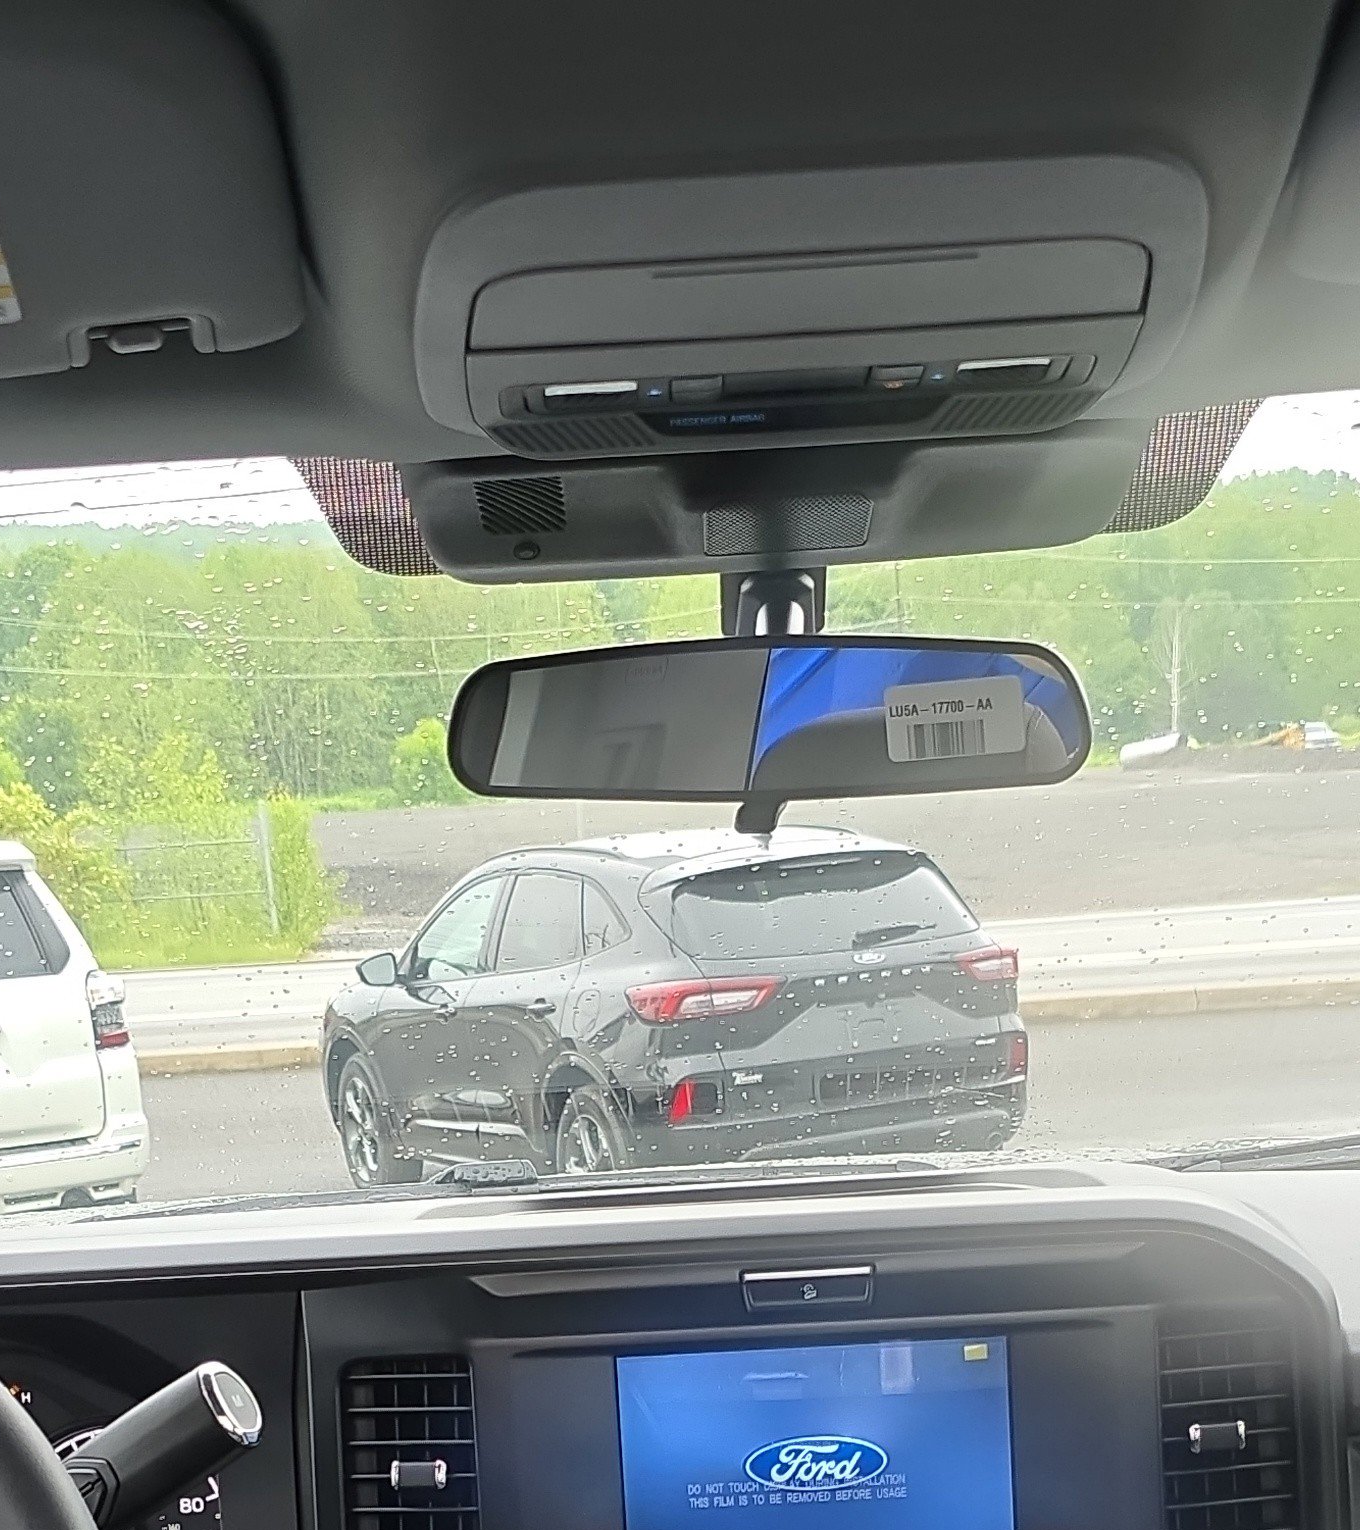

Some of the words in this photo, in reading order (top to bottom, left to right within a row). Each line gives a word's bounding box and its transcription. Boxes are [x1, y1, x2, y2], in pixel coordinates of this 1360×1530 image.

[21, 1392, 31, 1404] H
[770, 1443, 862, 1482] Ford
[687, 1484, 702, 1495] DO
[706, 1482, 724, 1494] NOT
[728, 1481, 759, 1493] TOUCH
[180, 1497, 205, 1513] 80
[689, 1497, 709, 1508] THIS
[713, 1496, 735, 1507] FILM
[739, 1495, 748, 1506] IS
[752, 1494, 765, 1505] TO
[770, 1493, 782, 1504] BE
[787, 1491, 831, 1503] REMOVED
[836, 1489, 872, 1501] BEFORE
[876, 1487, 907, 1499] USAGE
